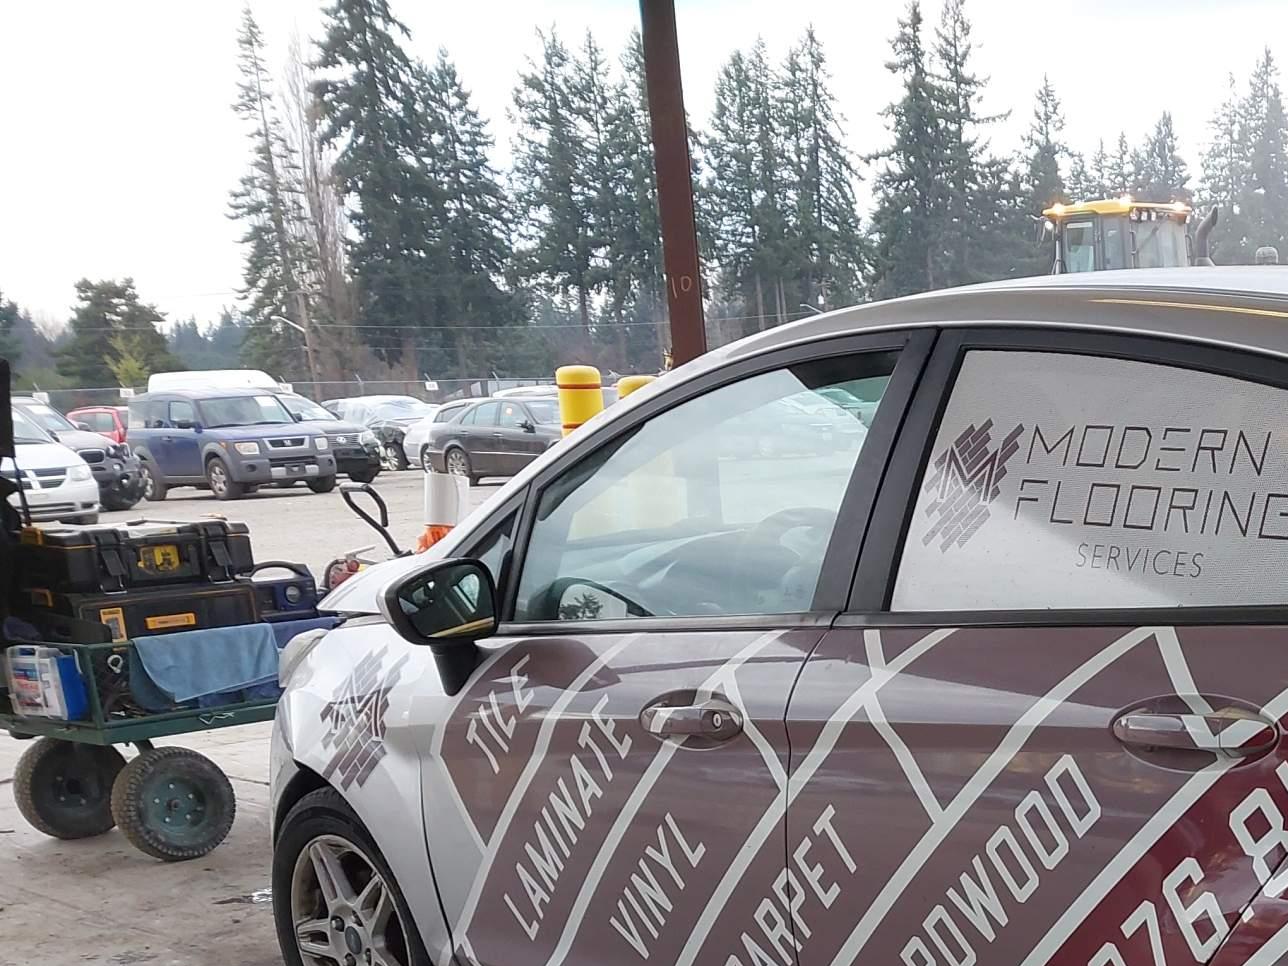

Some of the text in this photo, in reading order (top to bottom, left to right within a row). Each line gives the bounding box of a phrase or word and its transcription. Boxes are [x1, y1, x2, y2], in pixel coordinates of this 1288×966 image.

[671, 276, 692, 299] 10
[1026, 423, 1273, 476] MODERN
[1074, 542, 1205, 578] SERVICES
[466, 653, 536, 774] TILE
[503, 693, 633, 941] LAMINATE
[609, 812, 707, 960] VINYL
